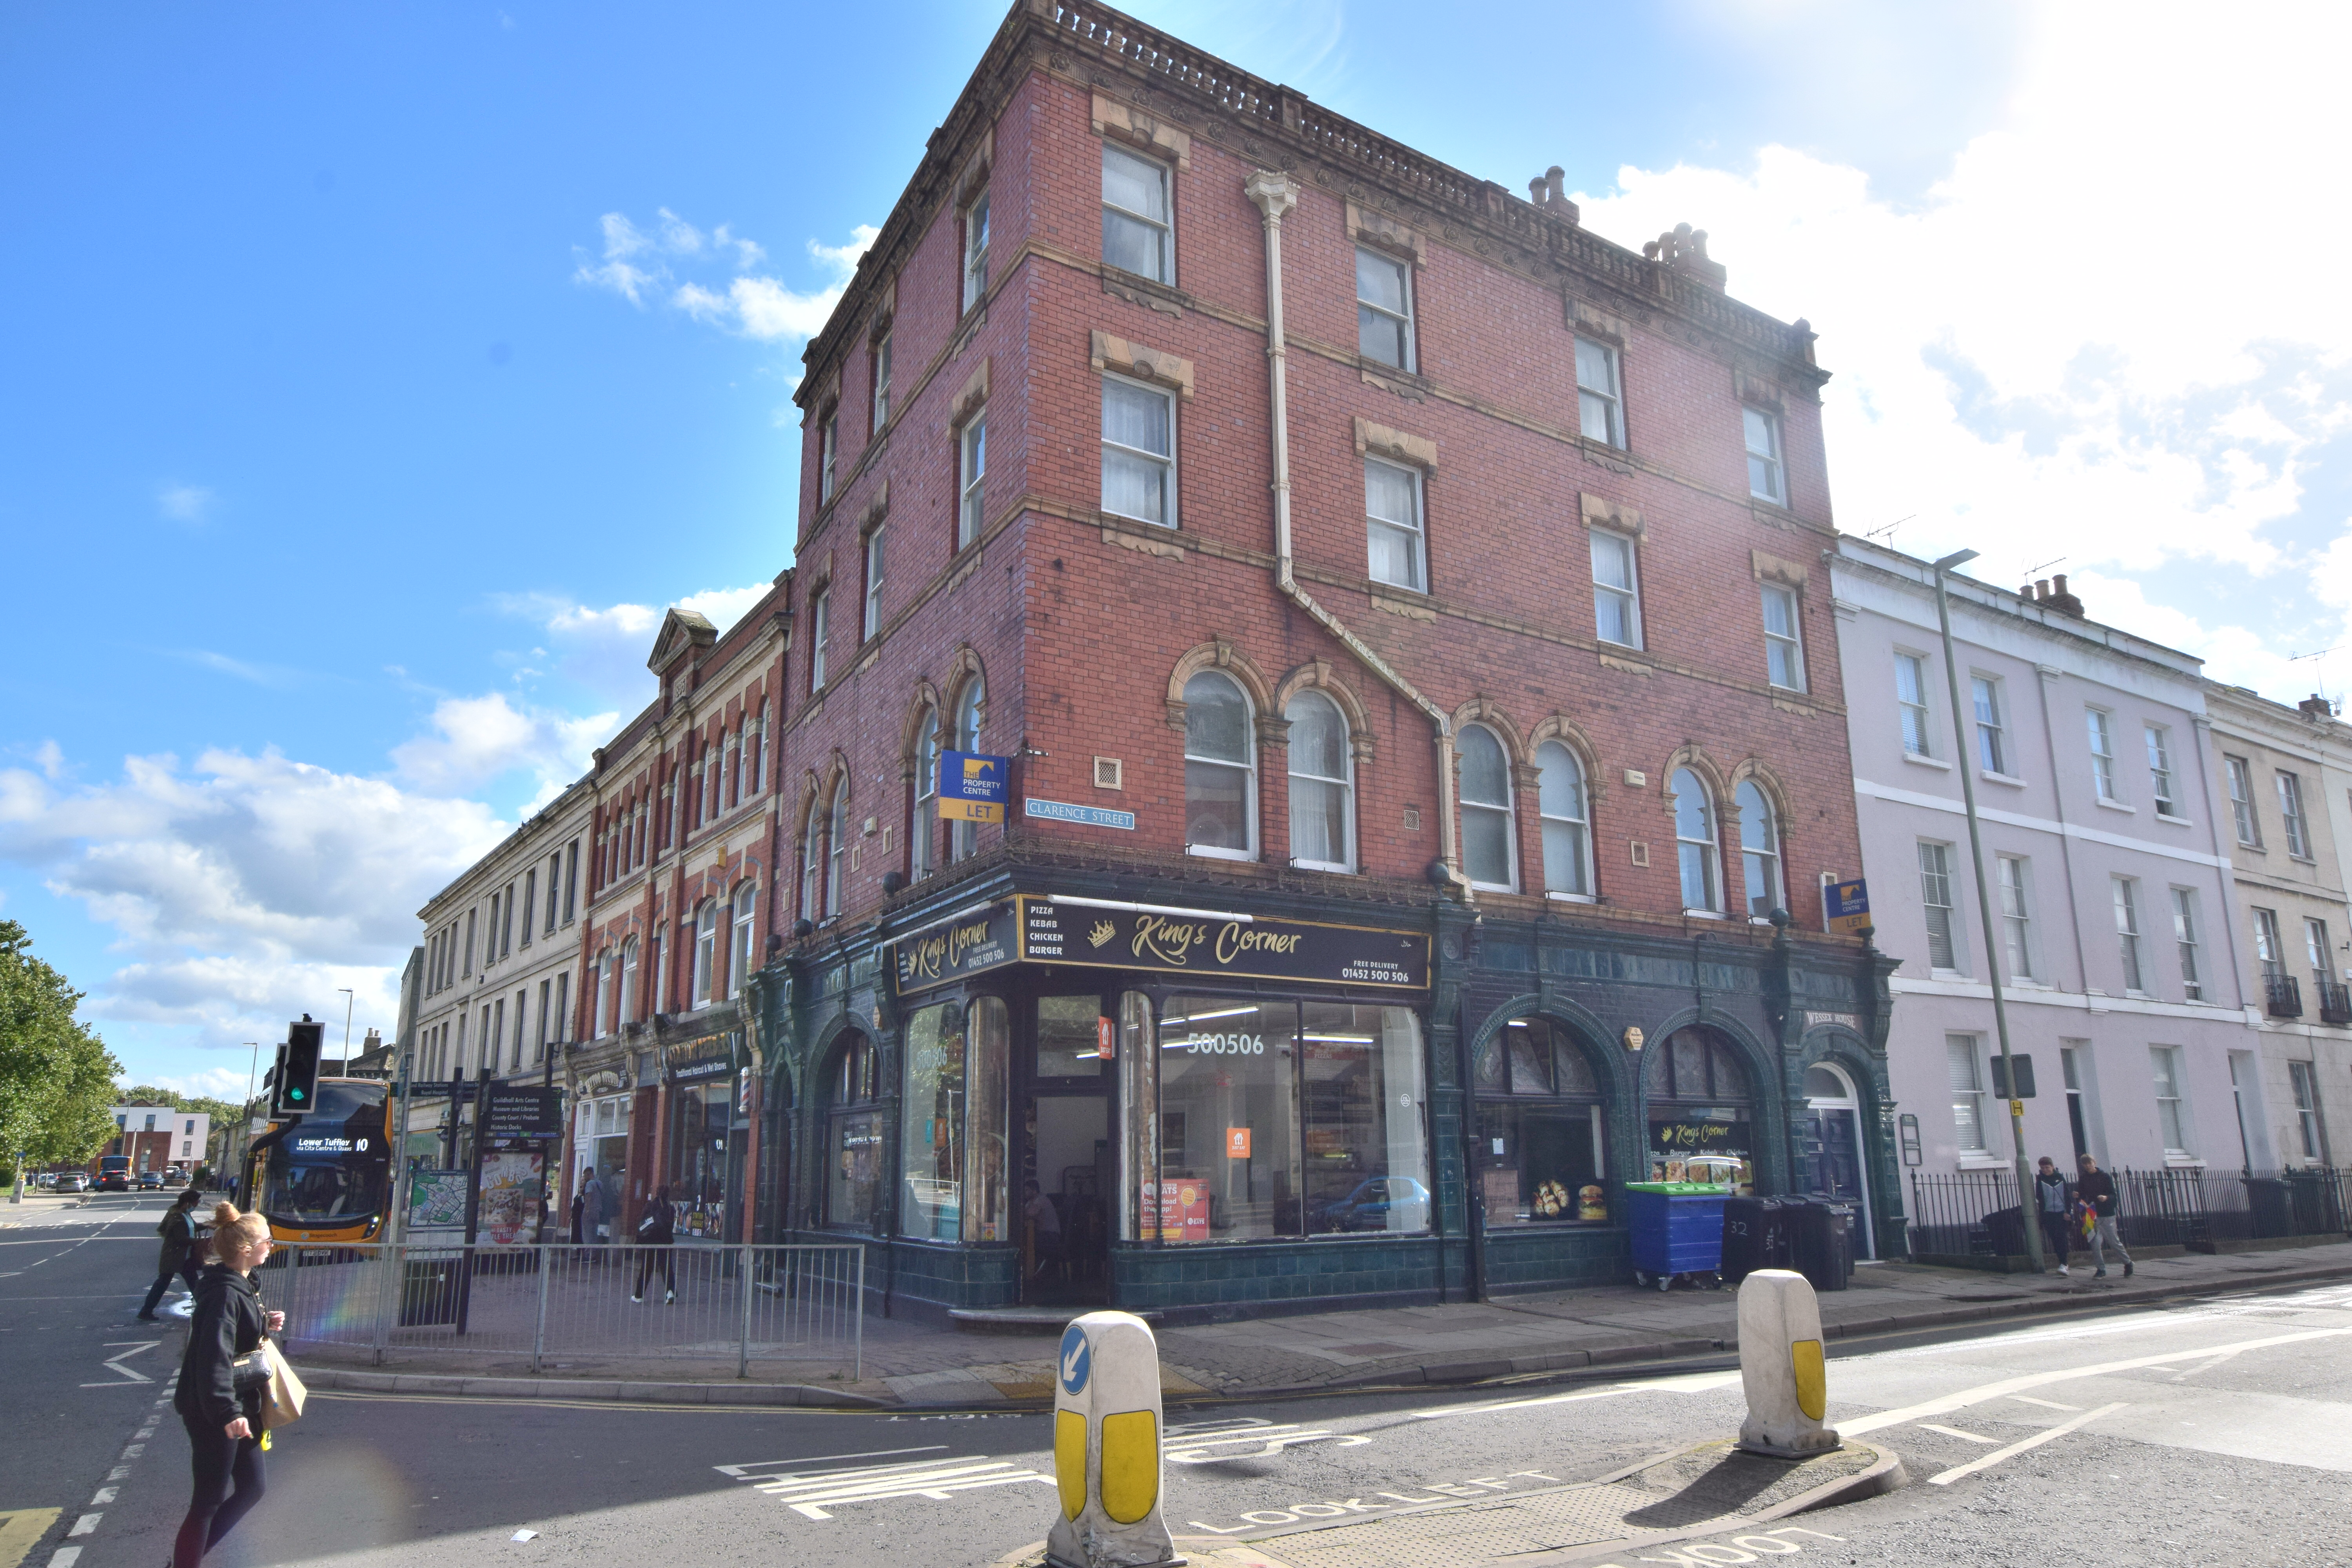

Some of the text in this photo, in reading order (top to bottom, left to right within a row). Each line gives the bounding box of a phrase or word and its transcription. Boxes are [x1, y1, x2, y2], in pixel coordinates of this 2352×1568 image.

[963, 779, 1000, 789] PROPERTY
[963, 787, 991, 796] CENTRE
[967, 804, 992, 818] LET
[1030, 803, 1130, 825] CLARENCE STREET
[1031, 906, 1053, 915] PIZZA
[1030, 919, 1057, 928] KEBAB
[1847, 916, 1862, 927] LET
[950, 921, 988, 967] Corner
[1029, 933, 1063, 942] CHICKEN
[1132, 915, 1301, 965] King's Corner
[982, 940, 997, 951] DELIVERY
[1029, 946, 1062, 955] BURGER
[968, 948, 1004, 968] 01452 500 506
[1370, 962, 1398, 970] DELIVERY
[1342, 968, 1408, 982] 01452 500 506
[1807, 1012, 1855, 1028] WESSEX HOUSE
[1187, 1033, 1264, 1054] 500506
[2013, 1102, 2023, 1114] H
[1701, 1125, 1728, 1142] Corner
[356, 1138, 368, 1151] 10
[1731, 1221, 1747, 1236] 32
[1766, 1239, 1774, 1250] 32
[1188, 1470, 1560, 1533] LOOK LEFT
